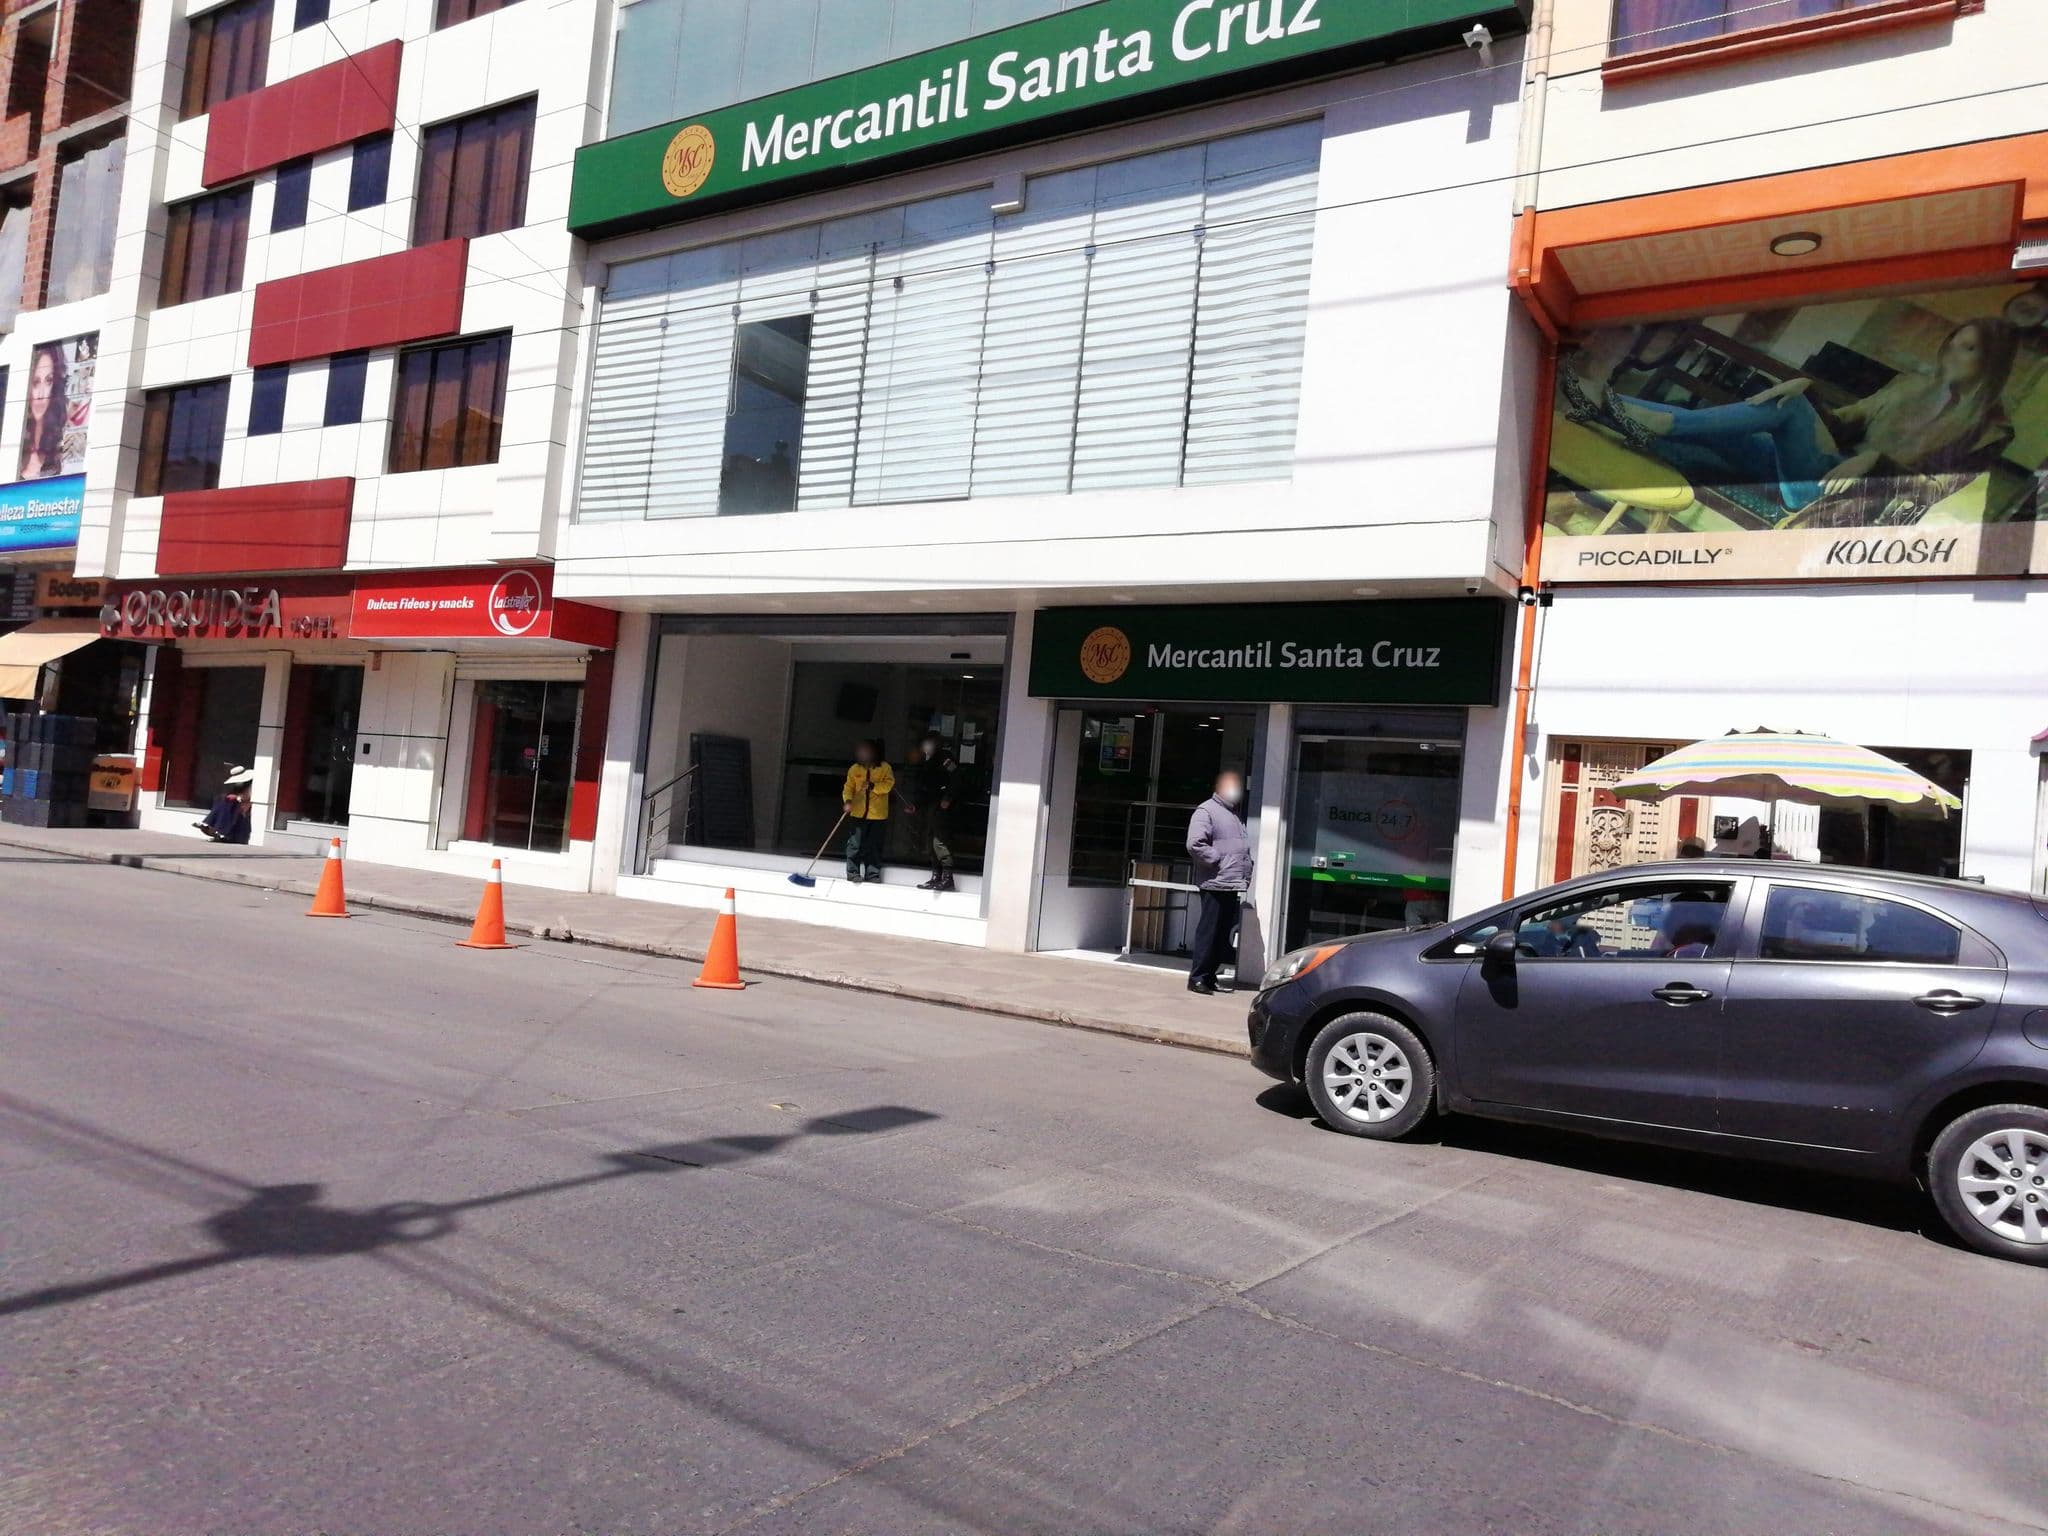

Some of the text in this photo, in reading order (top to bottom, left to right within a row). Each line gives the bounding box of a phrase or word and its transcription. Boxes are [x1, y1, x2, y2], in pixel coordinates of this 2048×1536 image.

[741, 0, 1322, 171] Mercantil Santa Cruz
[26, 496, 80, 519] Bienestar
[1578, 548, 1723, 567] PICCADILLY
[1825, 537, 1959, 565] KOLOSH
[48, 579, 100, 602] Bodega
[126, 587, 282, 629] ORQUIDEA
[367, 596, 474, 612] Dulces Fideos y snacks
[1147, 640, 1441, 669] Mercantil Santa Cruz
[1328, 806, 1412, 828] Banca 247
